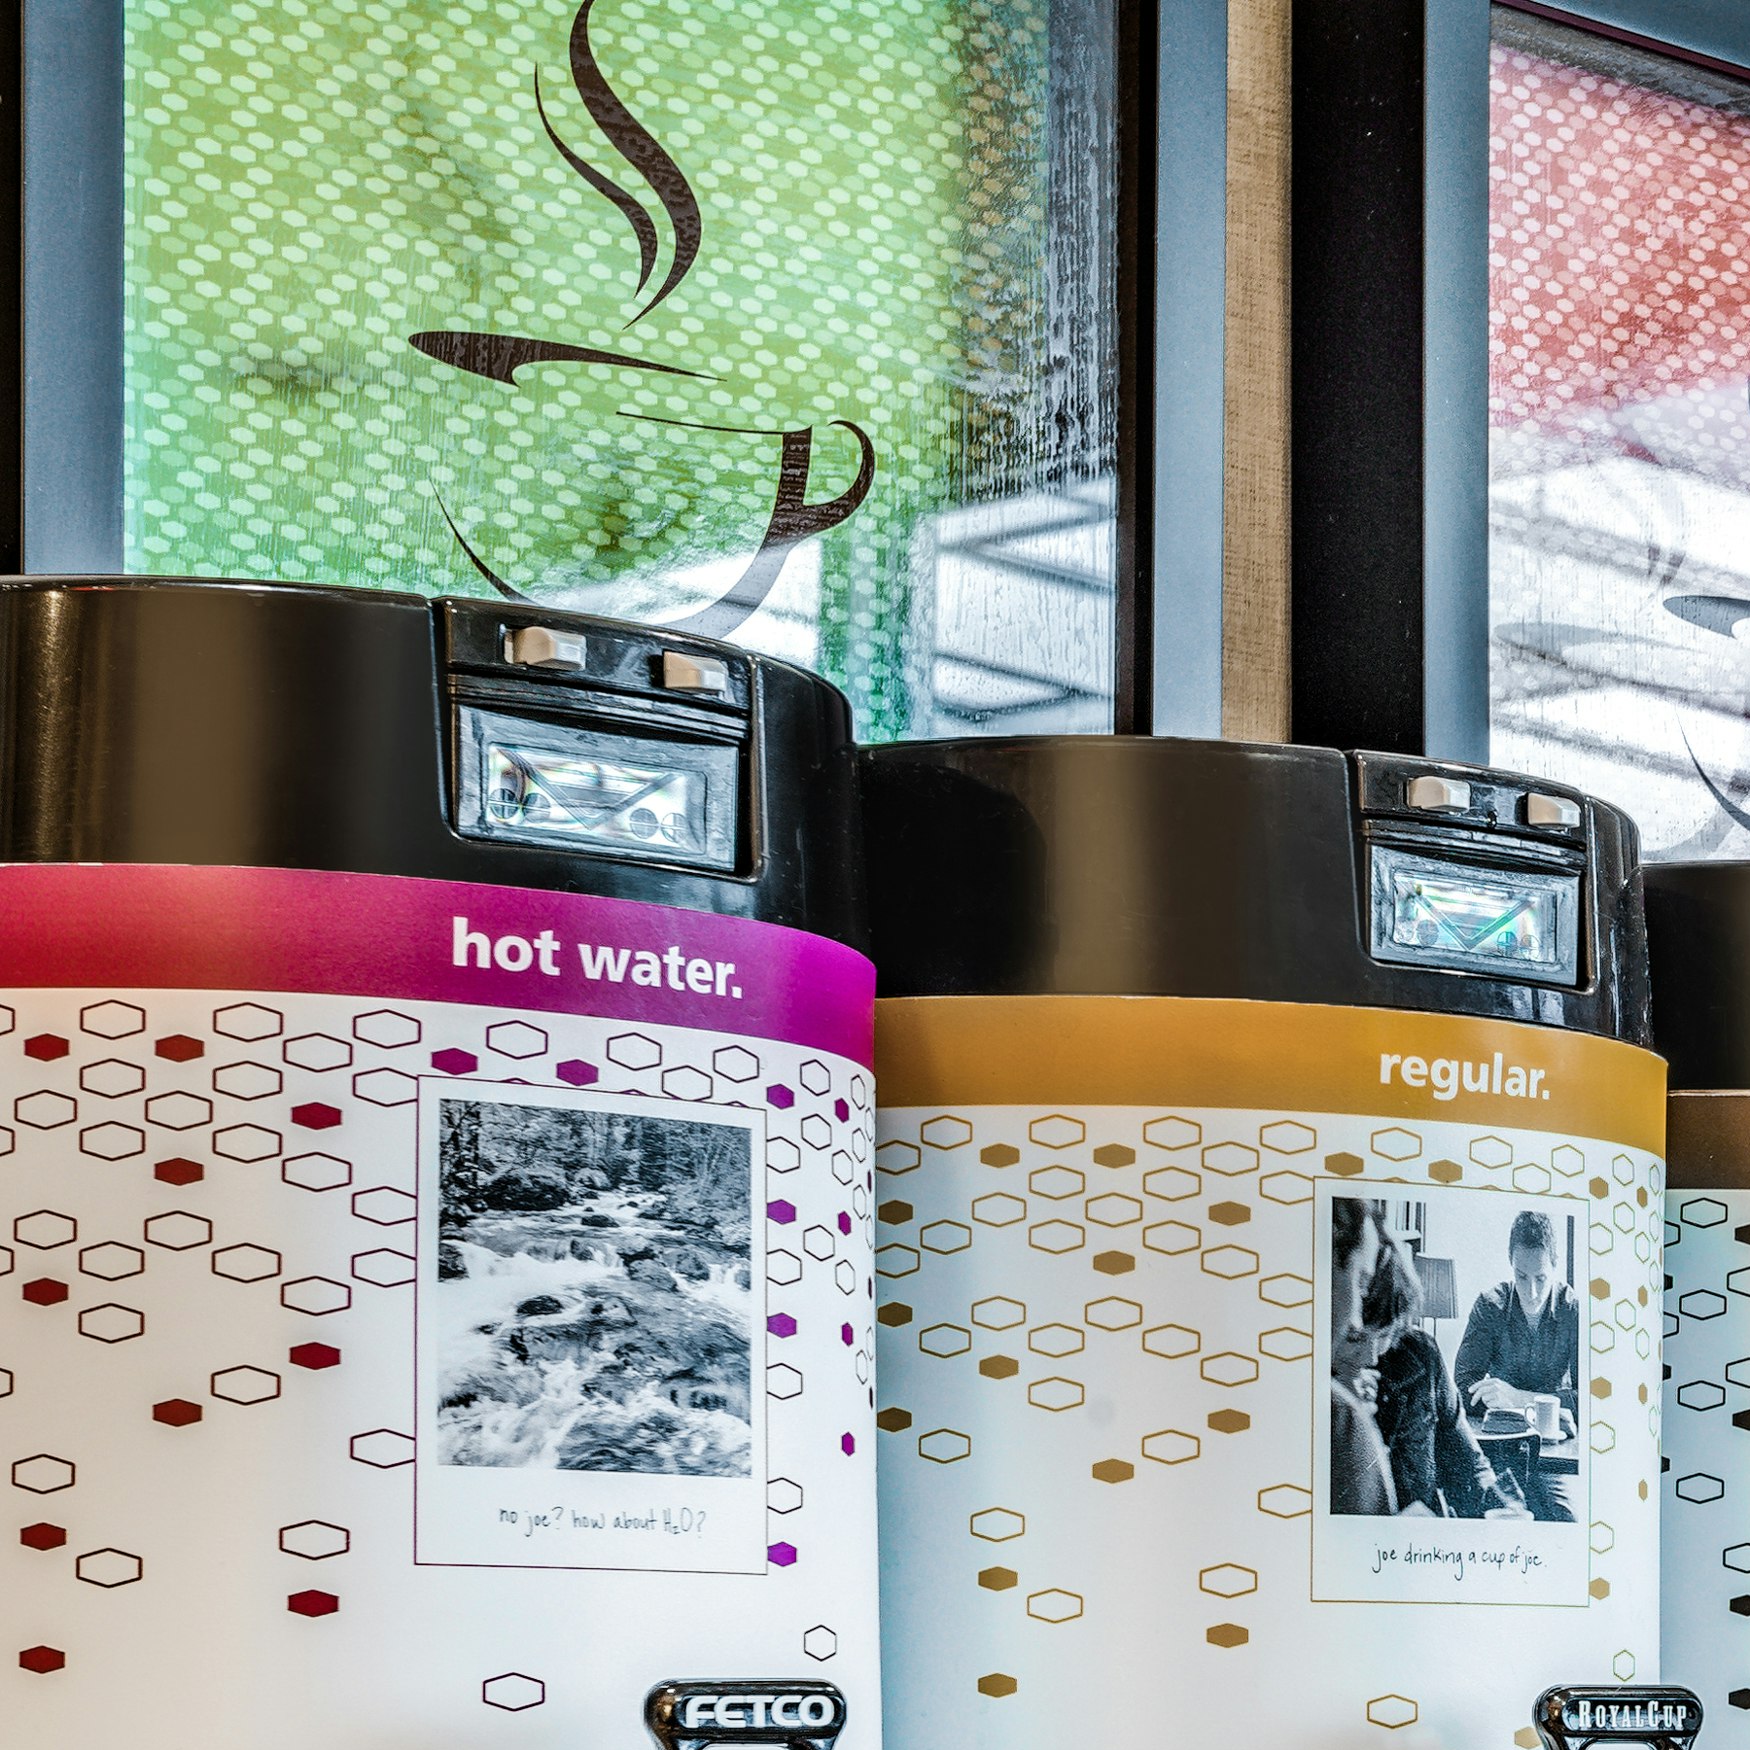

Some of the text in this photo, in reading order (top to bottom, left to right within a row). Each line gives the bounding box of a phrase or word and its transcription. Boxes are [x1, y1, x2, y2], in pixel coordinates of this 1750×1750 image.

[453, 916, 743, 999] hot water.
[1380, 1052, 1550, 1100] regular.
[499, 1508, 518, 1524] no
[524, 1506, 564, 1537] joe?
[572, 1509, 605, 1530] how
[613, 1508, 657, 1530] about
[1372, 1543, 1397, 1573] joe
[1404, 1542, 1463, 1581] drinking
[1468, 1551, 1476, 1564] a
[1481, 1551, 1506, 1570] cup
[1509, 1545, 1520, 1563] of
[686, 1695, 835, 1728] FETCO
